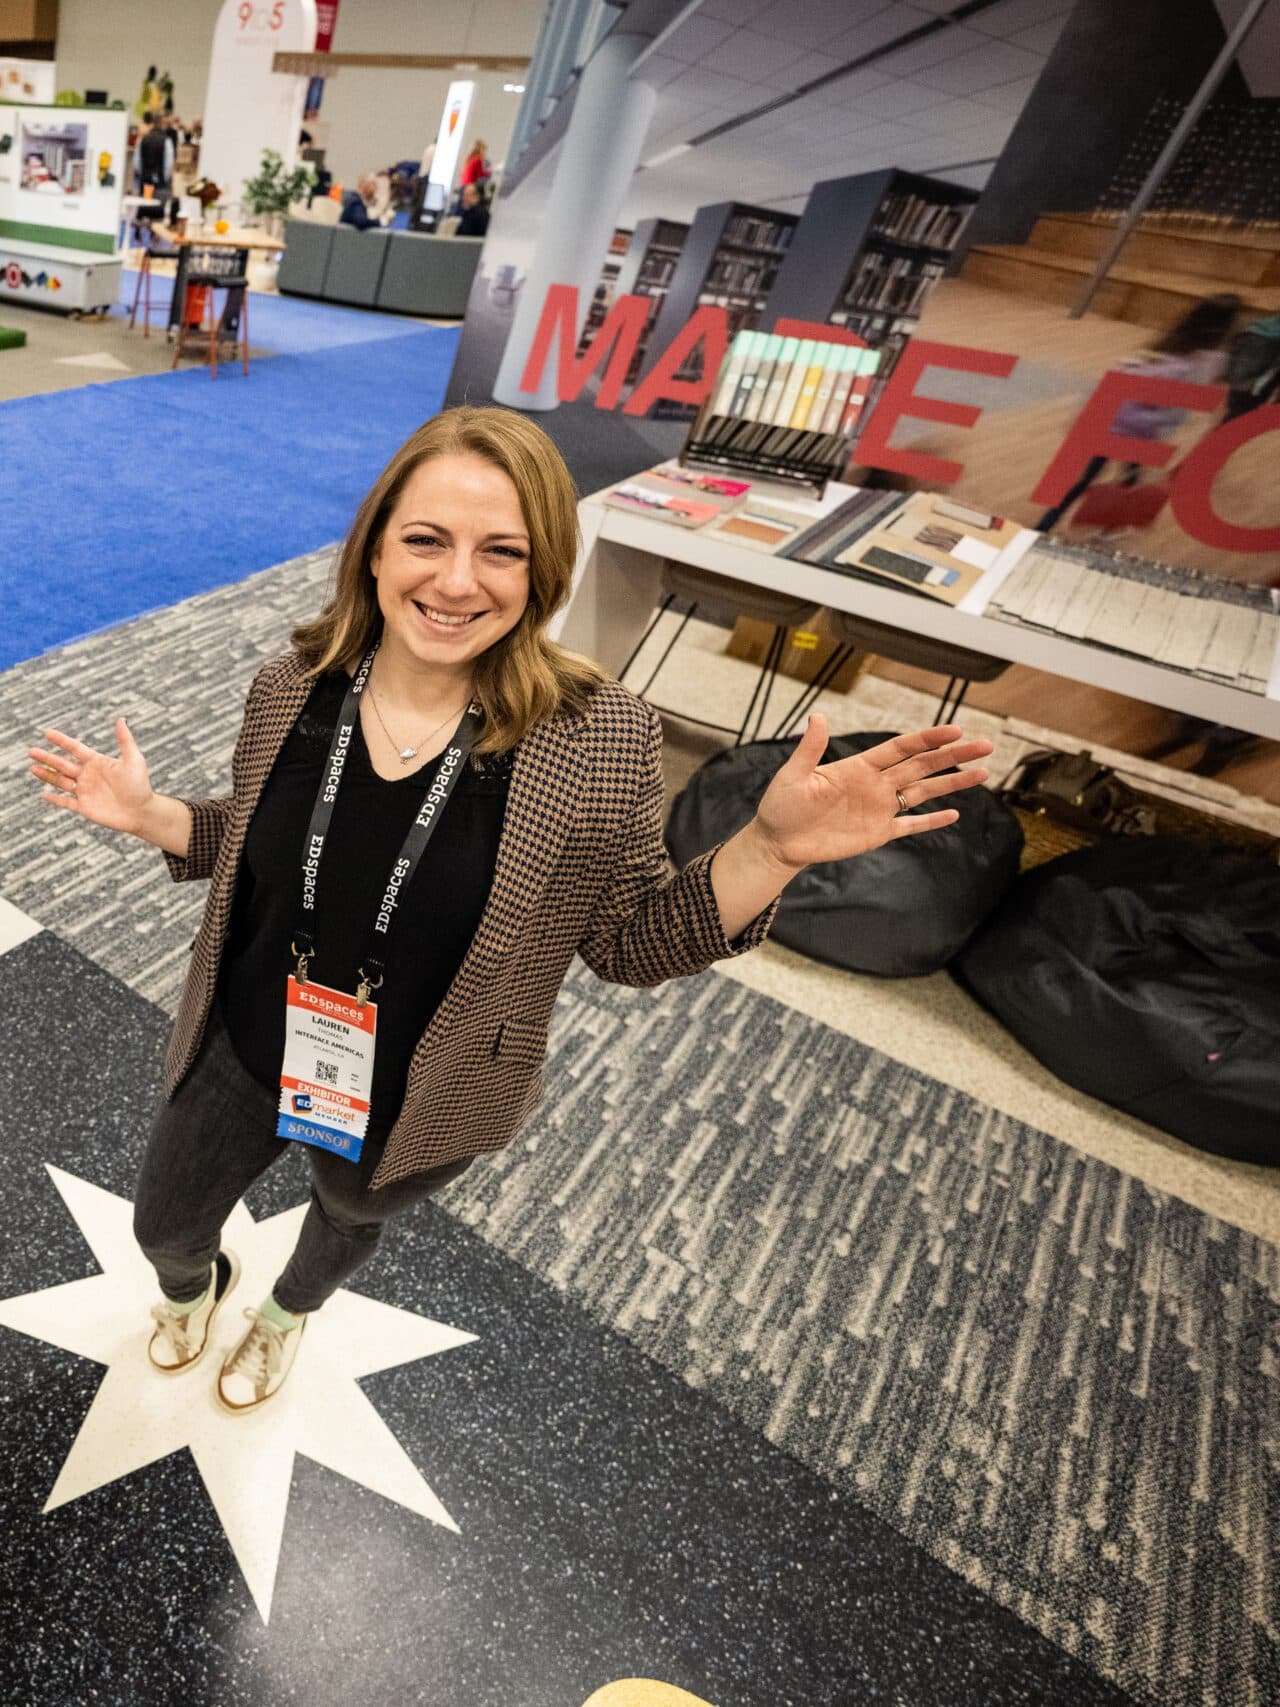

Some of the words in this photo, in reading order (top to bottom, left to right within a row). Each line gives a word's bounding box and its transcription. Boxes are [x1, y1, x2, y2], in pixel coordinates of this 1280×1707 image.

[323, 725, 352, 803] EDspaces
[416, 747, 461, 827] EDspaces
[302, 835, 324, 911] EDspaces
[375, 858, 410, 934] EDspaces
[299, 991, 364, 1021] EDspaces
[312, 1016, 350, 1035] LAUREN
[295, 1029, 329, 1045] INTERFACE
[331, 1042, 365, 1059] AMERICAS
[297, 1082, 352, 1107] EXHIBITOR
